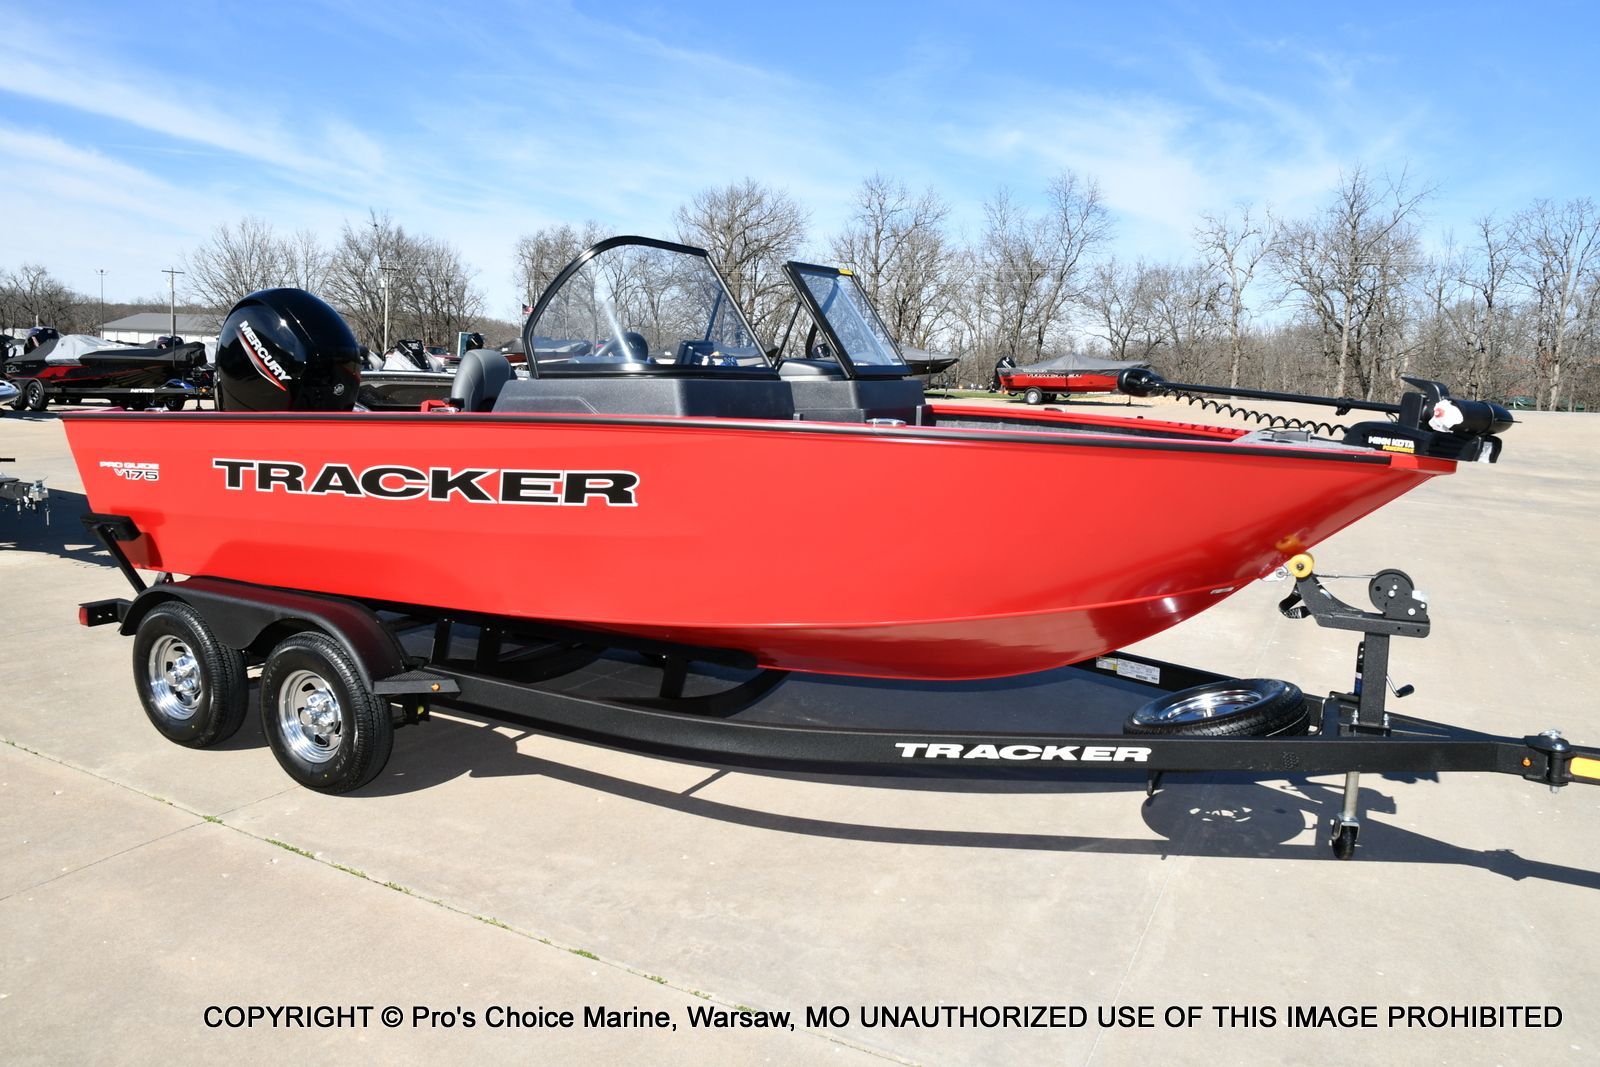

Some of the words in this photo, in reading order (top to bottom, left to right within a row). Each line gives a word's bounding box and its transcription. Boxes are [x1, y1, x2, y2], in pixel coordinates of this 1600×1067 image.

[239, 320, 292, 381] MERCURY
[1391, 438, 1415, 448] KOTA
[213, 458, 640, 507] TRACKER
[895, 742, 1152, 762] TRACKER
